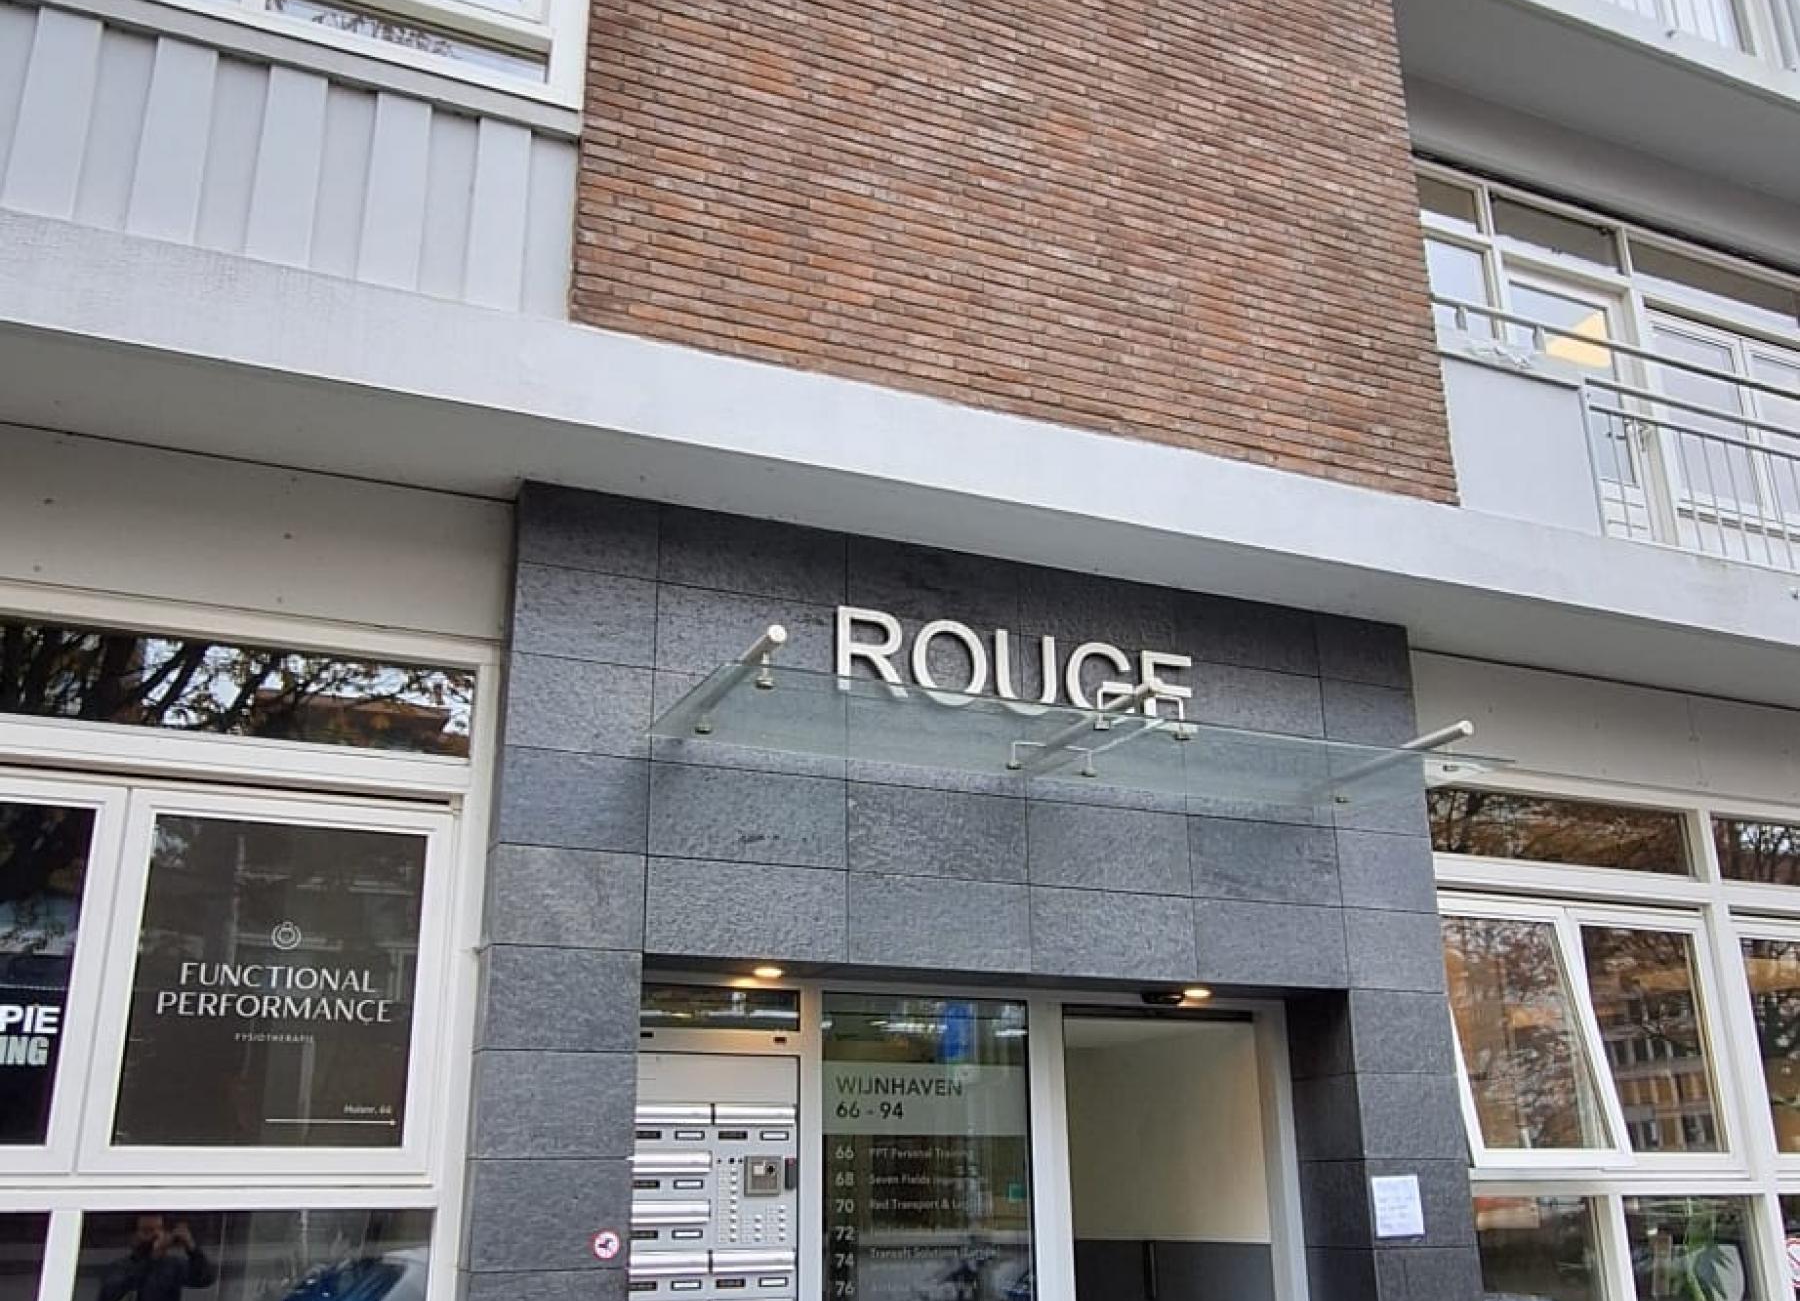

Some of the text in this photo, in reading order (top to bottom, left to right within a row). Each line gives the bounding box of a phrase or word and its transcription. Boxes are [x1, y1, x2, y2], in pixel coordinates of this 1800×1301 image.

[835, 605, 1197, 734] ROUGE
[180, 962, 376, 992] FUNCTIONAL
[157, 992, 393, 1023] PERFORMANCE
[836, 1075, 963, 1097] WIJNHAVEN
[836, 1101, 860, 1119] 66
[880, 1102, 904, 1120] 94
[835, 1146, 854, 1159] 66
[835, 1172, 854, 1186] 68
[835, 1200, 854, 1214] 70
[835, 1227, 855, 1241] 72
[835, 1254, 854, 1269] 74
[835, 1281, 855, 1296] 76
